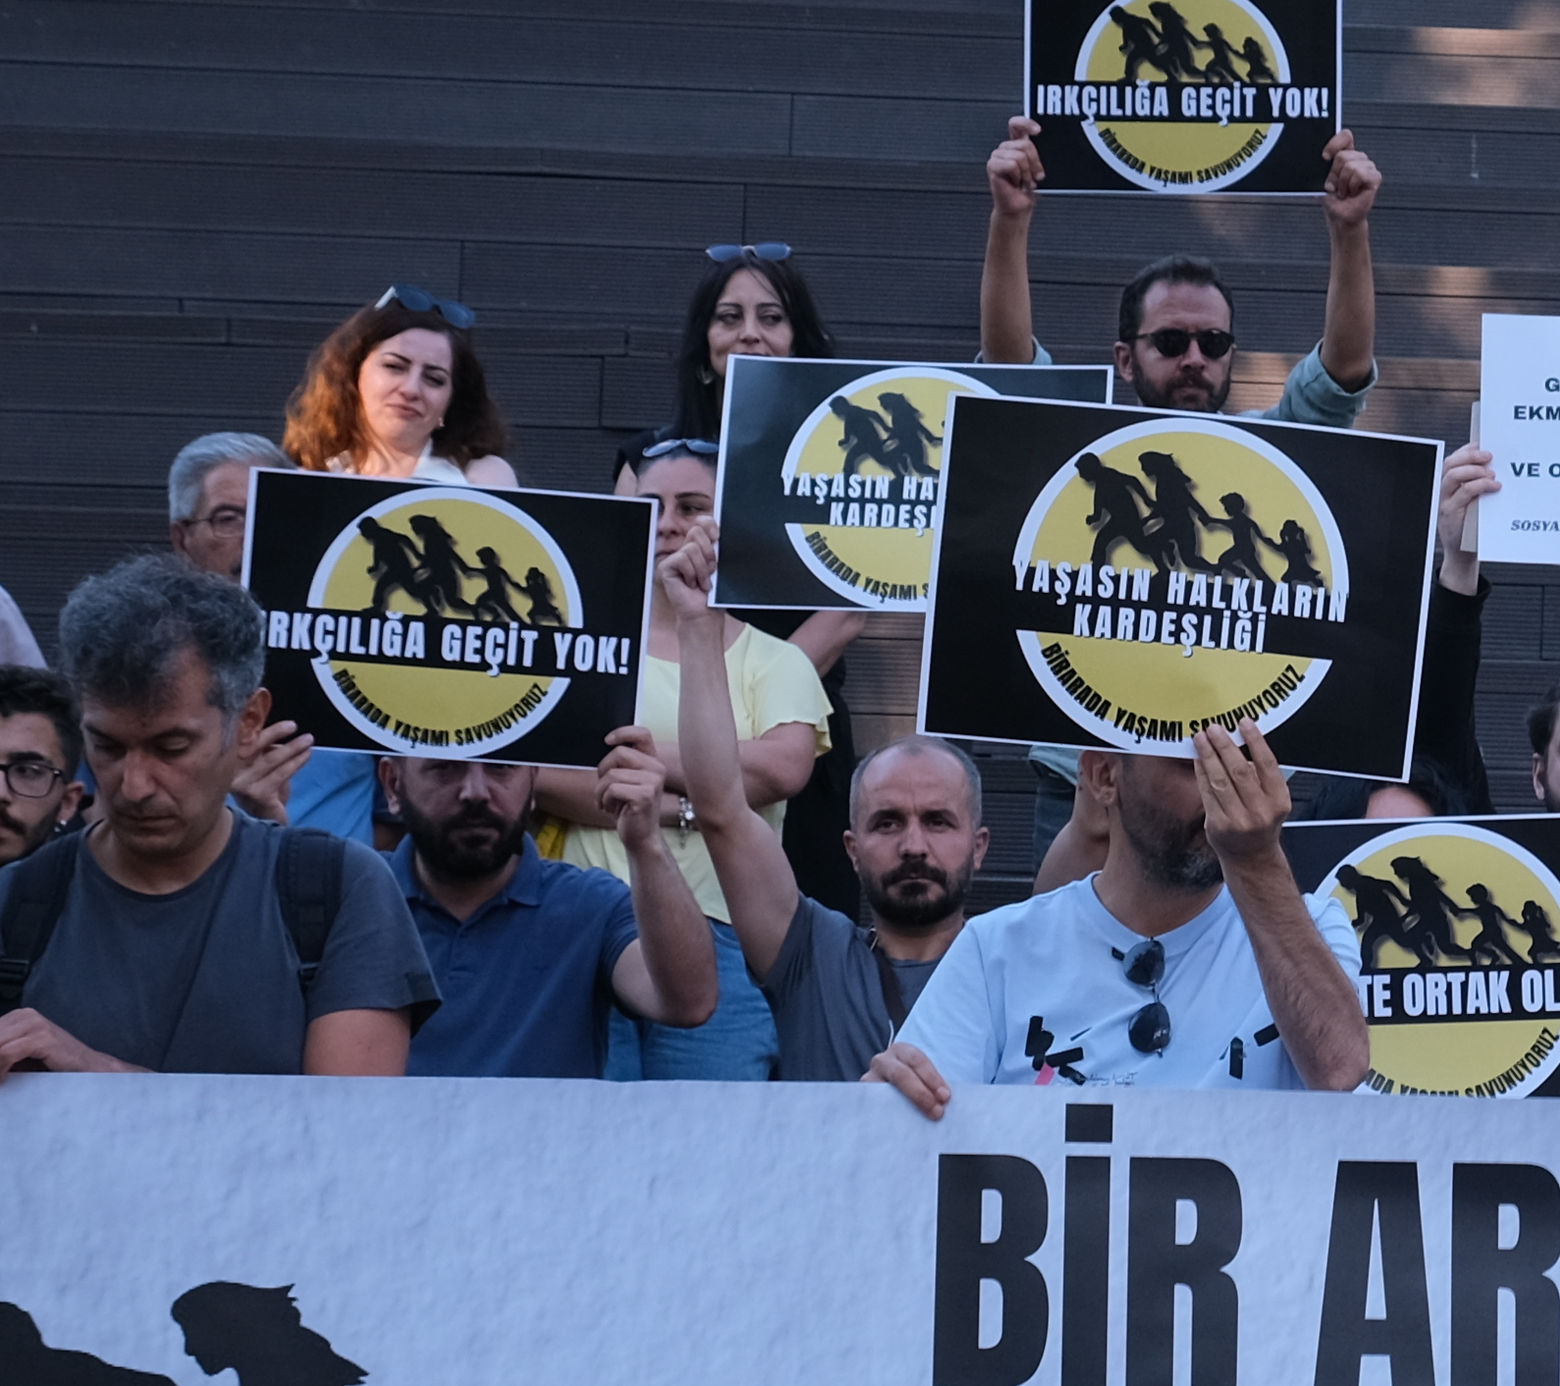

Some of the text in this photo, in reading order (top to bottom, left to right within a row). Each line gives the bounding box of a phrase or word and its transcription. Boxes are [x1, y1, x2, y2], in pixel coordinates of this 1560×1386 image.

[1037, 79, 1329, 126] IRKÇILIĞA GEÇİT YOK!
[1148, 165, 1194, 188] YAŞAMI
[1196, 128, 1268, 183] SAVUNUYORUZ
[781, 472, 890, 505] YAŞASIN
[1510, 462, 1541, 478] VE
[829, 501, 937, 537] KARDEŞ
[862, 576, 918, 604] YAŞAMI
[1012, 558, 1349, 624] YAŞASIN HALKLARIN
[266, 609, 631, 677] RKÇILIĞA GEÇİT YOK!
[1072, 602, 1267, 658] KARDEŞLİĞİ
[393, 719, 450, 749] YAŞAMI
[455, 682, 549, 747] SAVUNUYORUZ
[1041, 641, 1112, 722] BİRARADA
[1113, 706, 1183, 744] YAŞAMI
[1402, 970, 1512, 1018] ORTAK
